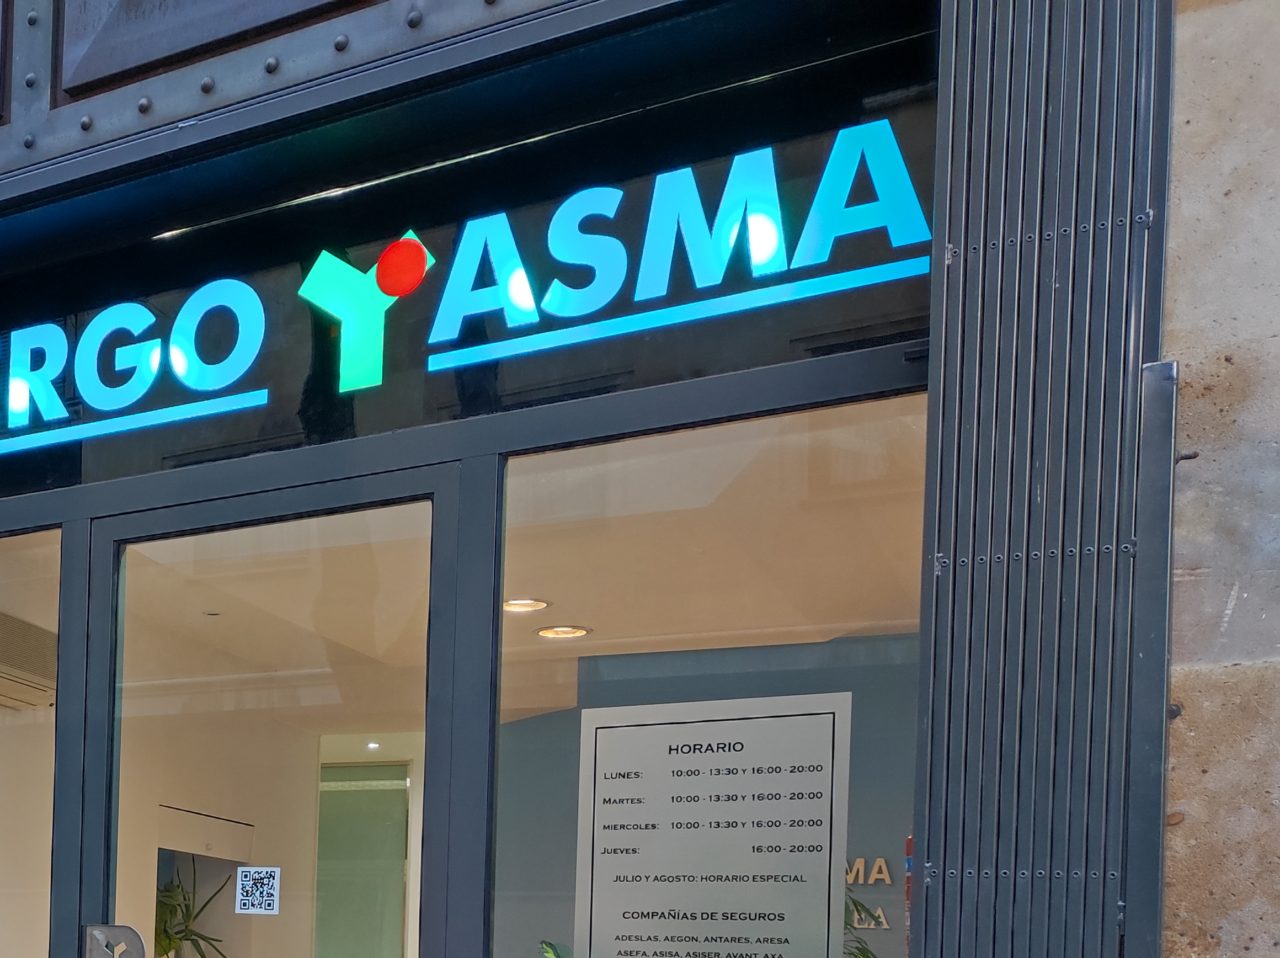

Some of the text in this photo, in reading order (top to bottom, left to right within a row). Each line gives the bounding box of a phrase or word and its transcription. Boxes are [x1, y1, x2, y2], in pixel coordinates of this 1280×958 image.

[427, 117, 933, 342] ASMA
[668, 742, 744, 755] HORARIO
[672, 769, 700, 777] 10:00
[710, 768, 738, 776] 13:30
[752, 766, 782, 774] 16:00
[789, 765, 823, 773] 20:00
[709, 794, 738, 802] 13:30
[789, 792, 823, 800] 20:00
[752, 820, 781, 828] 16:00
[789, 819, 823, 827] 20:00
[752, 845, 781, 853] 16:00
[789, 845, 823, 853] 20:00
[846, 857, 892, 885] MA
[613, 875, 642, 883] JULIO
[653, 875, 698, 883] AGOSTO:
[700, 875, 750, 883] HORARIO
[752, 875, 807, 883] ESPECIAL
[622, 909, 785, 921] COMPAÑÍAS DE SEGUROS
[615, 935, 661, 943] ADESLAS,
[703, 936, 753, 944] ANTARES,
